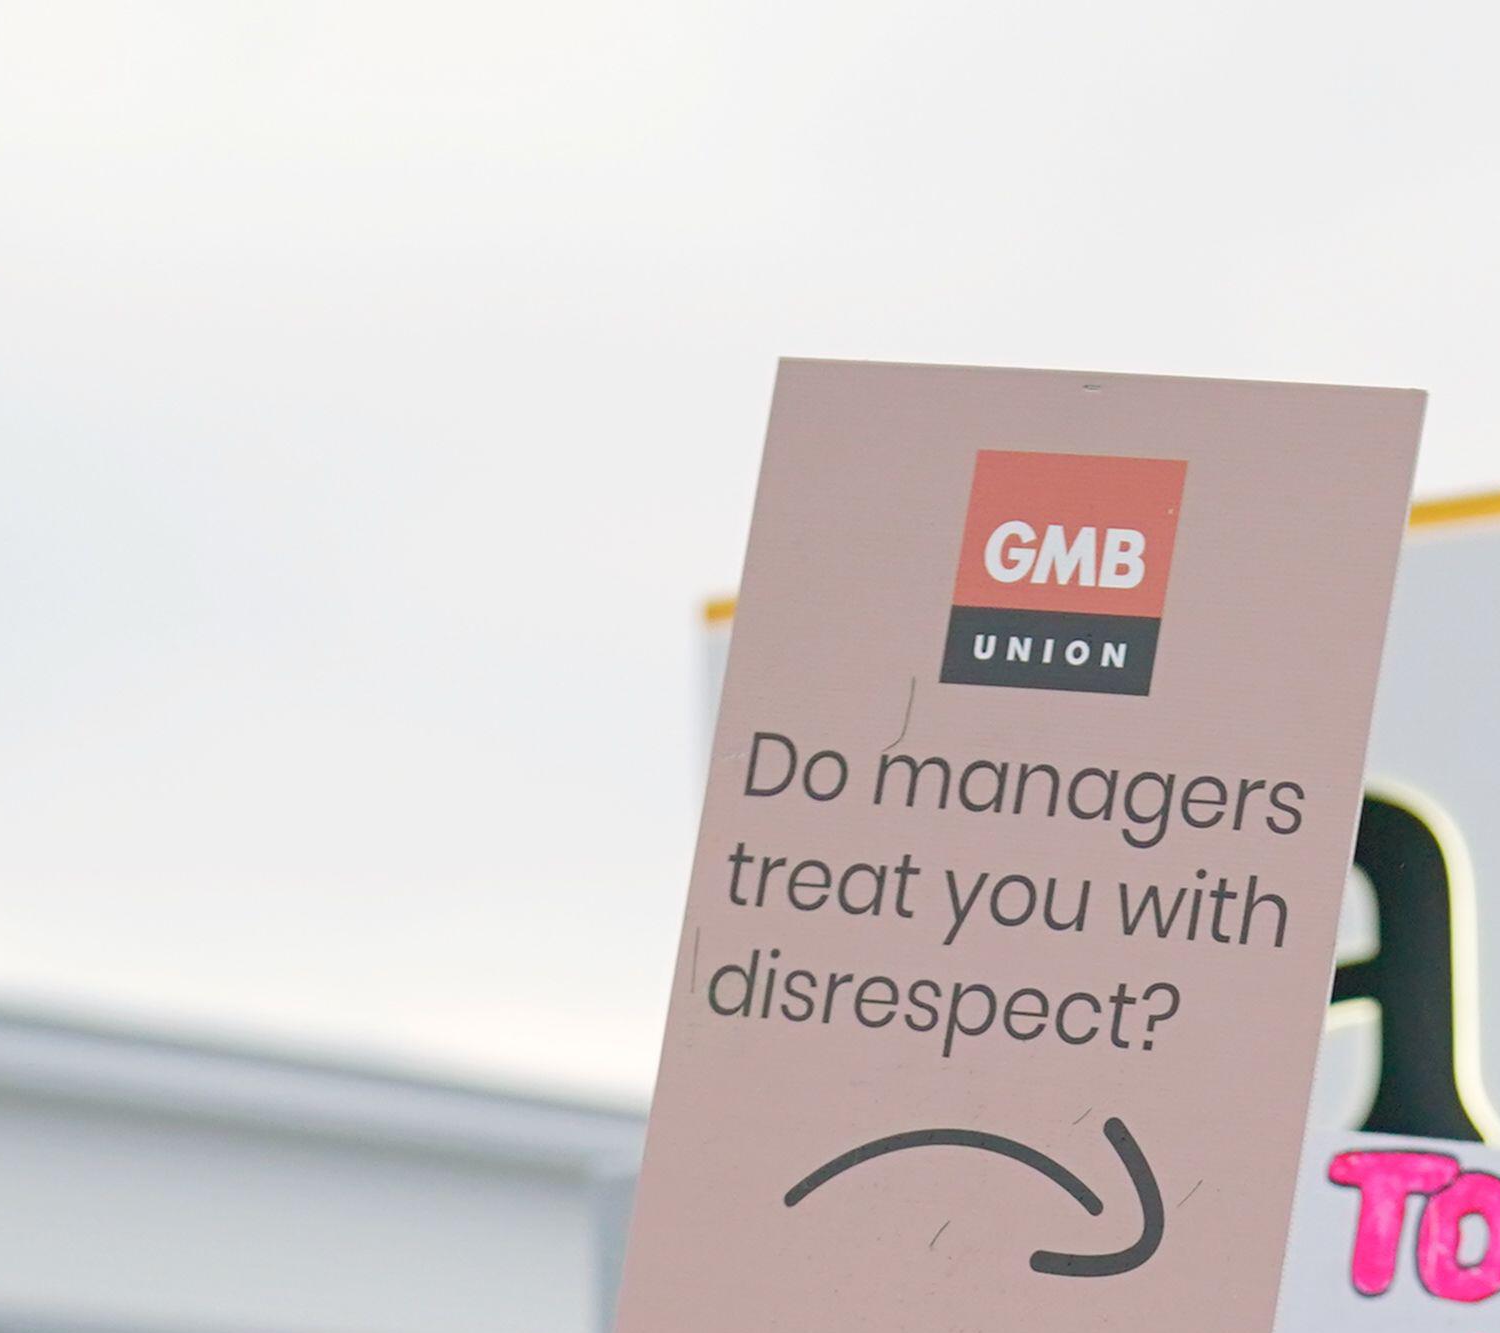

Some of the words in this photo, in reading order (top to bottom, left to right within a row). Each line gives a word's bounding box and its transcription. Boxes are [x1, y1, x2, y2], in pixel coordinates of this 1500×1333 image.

[984, 519, 1146, 590] GMB
[973, 634, 1128, 668] UNION
[743, 732, 848, 801] Do
[873, 747, 1306, 848] managers
[728, 842, 921, 917] treat
[942, 868, 1090, 945] you
[1119, 867, 1288, 946] with
[708, 950, 1180, 1057] disrespect?
